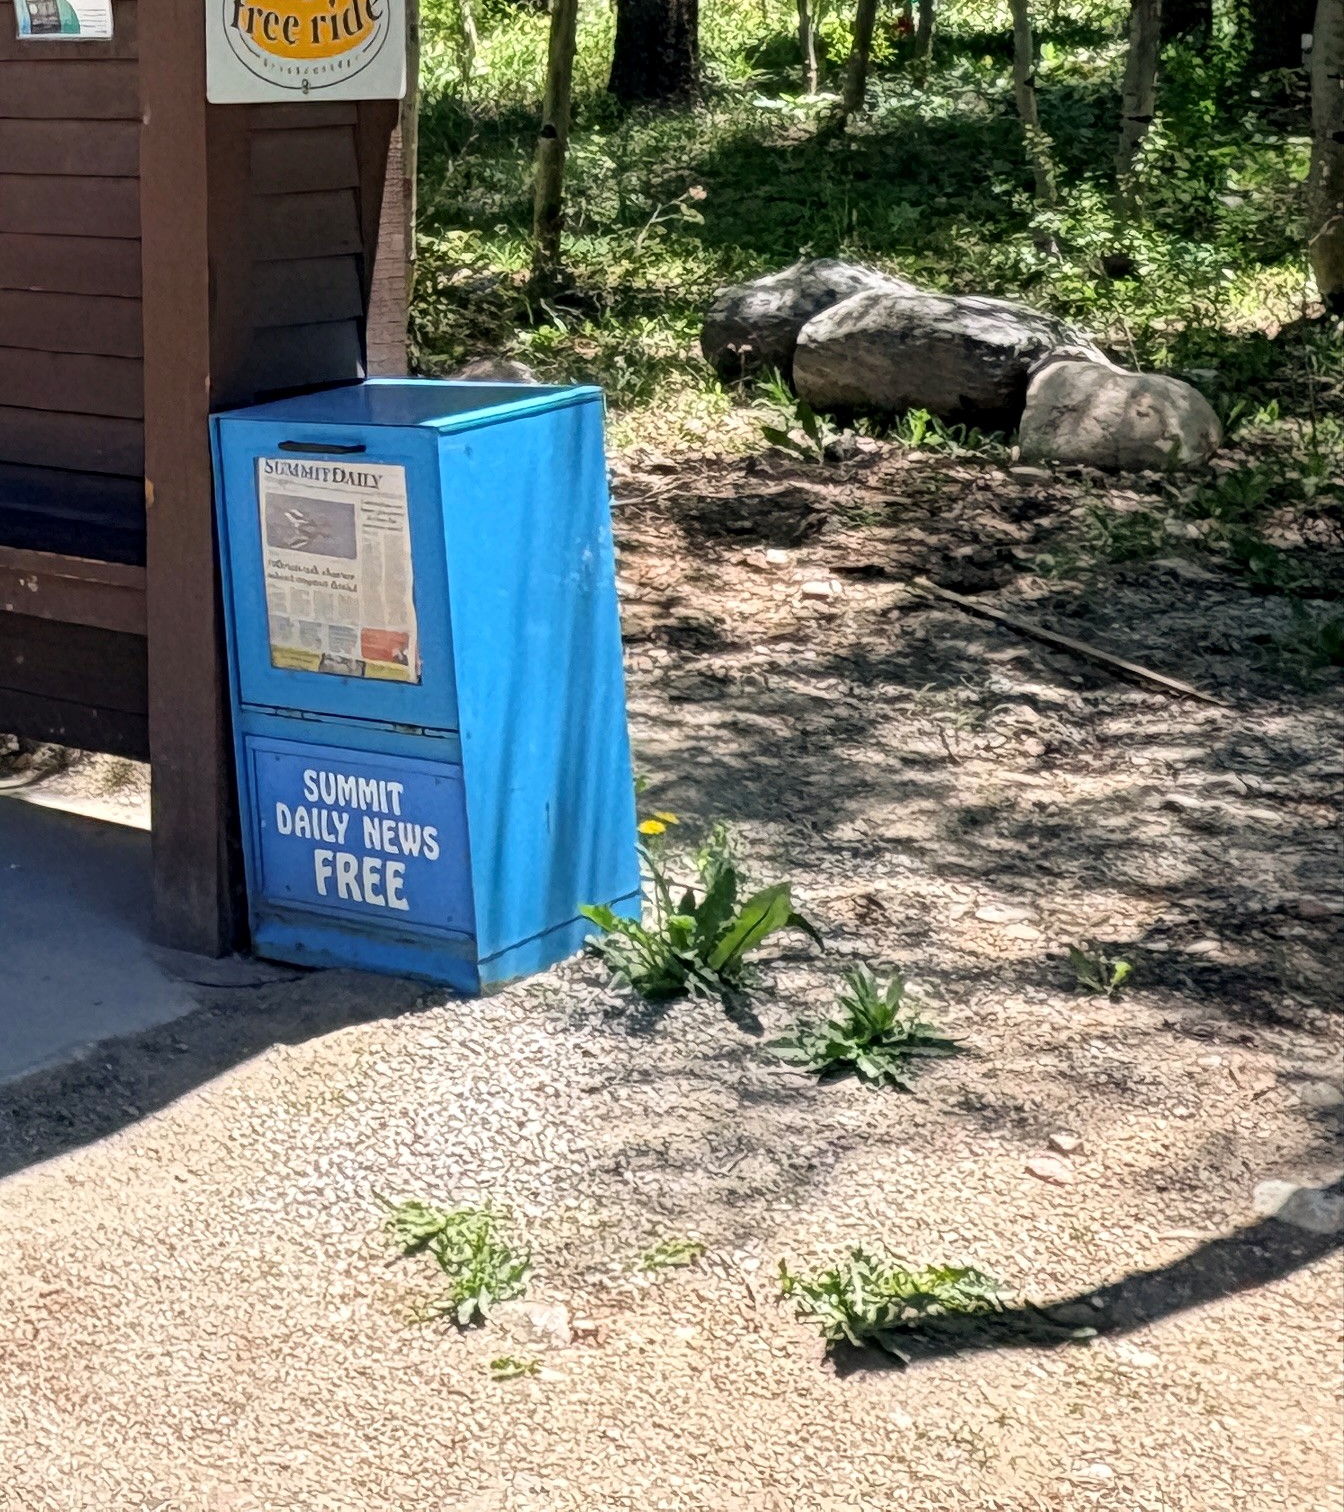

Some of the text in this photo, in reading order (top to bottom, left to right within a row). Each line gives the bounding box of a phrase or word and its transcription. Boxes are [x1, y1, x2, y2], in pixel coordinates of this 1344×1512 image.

[304, 769, 404, 816] SUMMIT
[276, 802, 440, 861] DAILY NEWS
[314, 849, 410, 910] FREE
